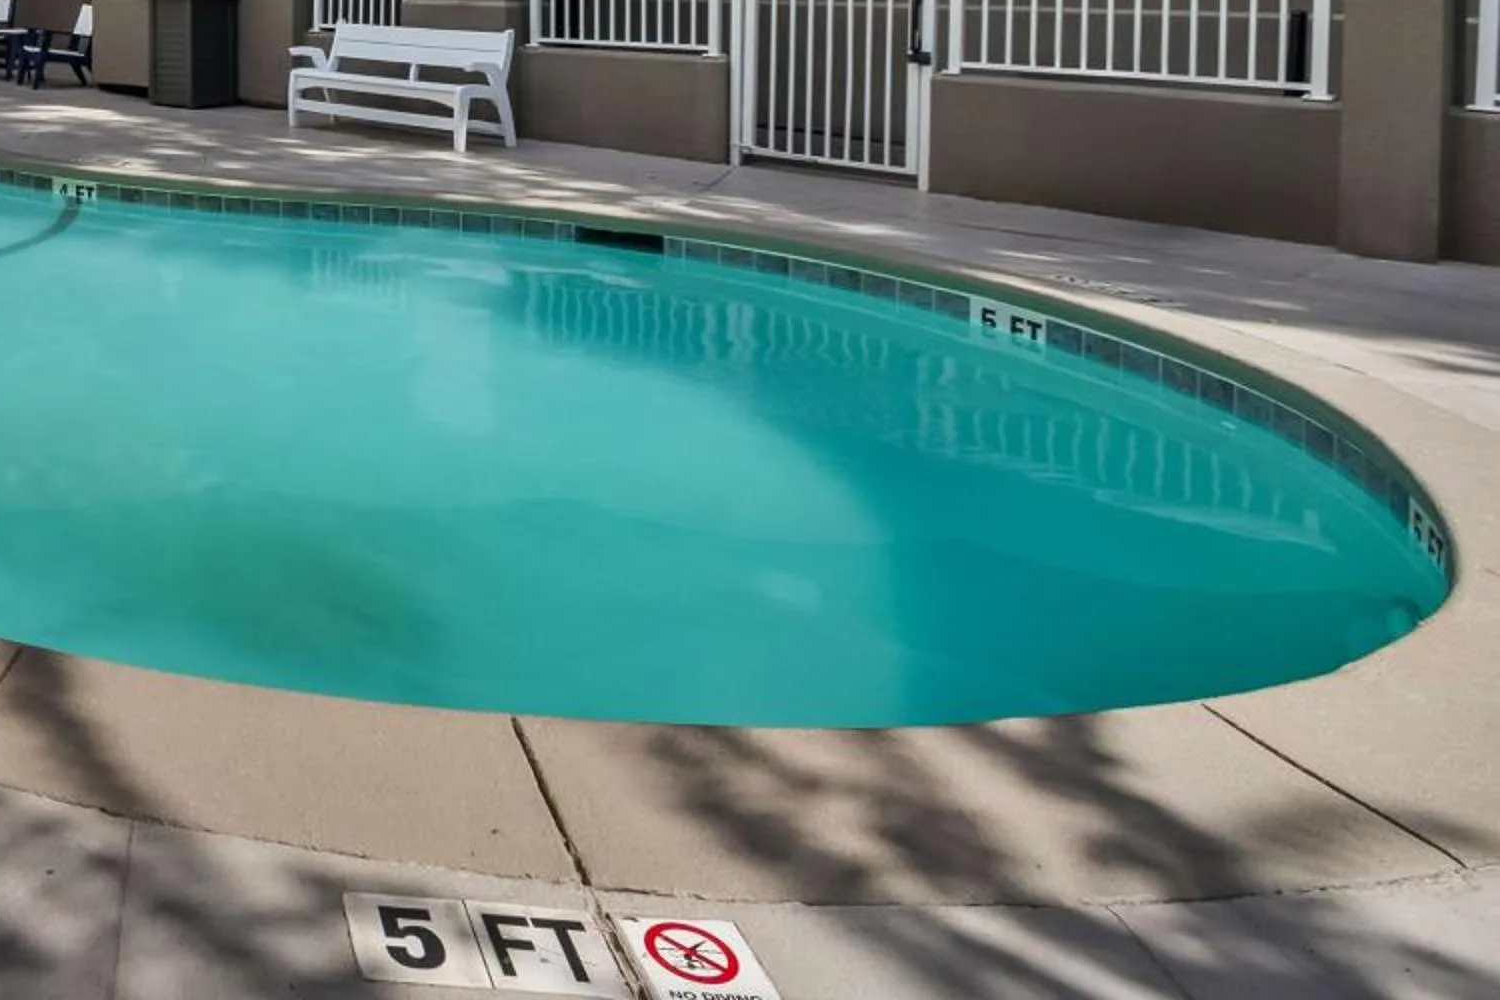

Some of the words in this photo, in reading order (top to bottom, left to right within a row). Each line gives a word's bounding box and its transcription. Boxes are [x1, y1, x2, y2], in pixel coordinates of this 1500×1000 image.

[981, 307, 997, 329] 5
[1010, 315, 1043, 341] FT
[378, 905, 446, 969] 5
[482, 912, 591, 983] FT
